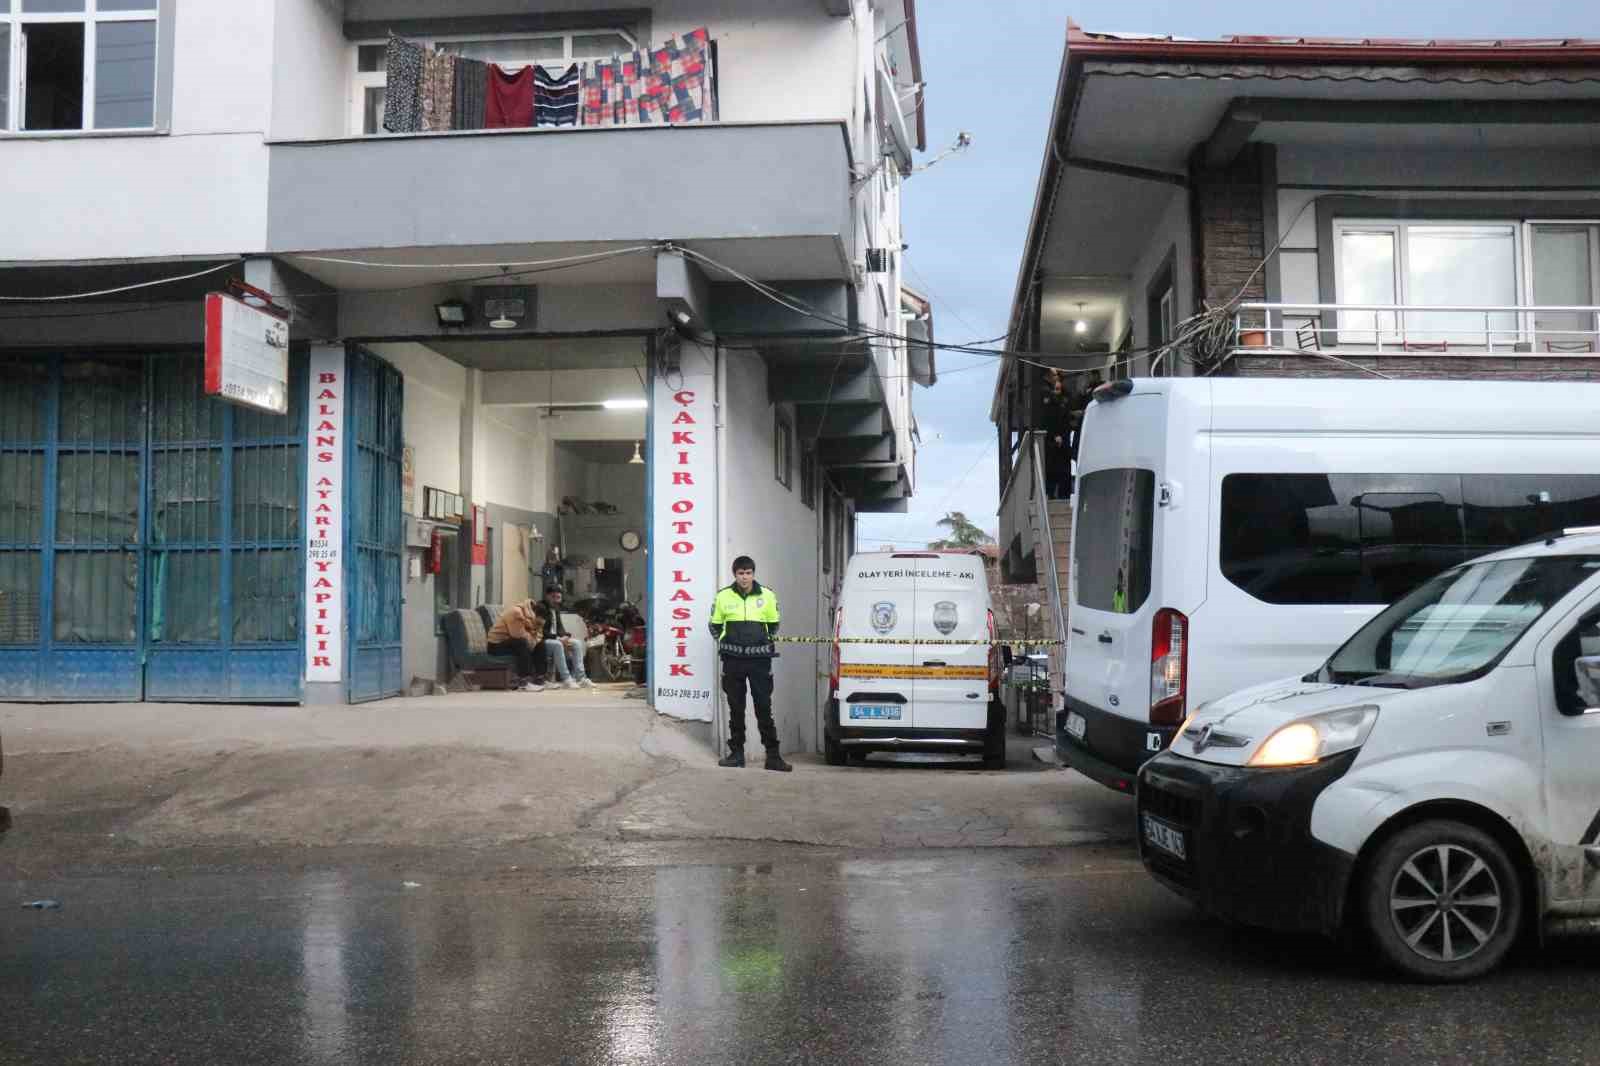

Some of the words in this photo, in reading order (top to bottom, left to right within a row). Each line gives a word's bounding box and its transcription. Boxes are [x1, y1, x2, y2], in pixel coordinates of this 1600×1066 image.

[316, 373, 337, 463] BALANS
[672, 390, 696, 486] ÇAKIR
[315, 477, 333, 539] AYARI
[671, 499, 694, 555] OTO
[858, 570, 881, 578] OLAY
[882, 569, 903, 578] YERİ
[904, 569, 953, 578] İNCELEME
[312, 561, 333, 666] YAPILIR
[669, 570, 694, 676] LASTİK
[663, 688, 678, 697] 0534
[679, 688, 691, 698] 298
[702, 690, 710, 699] 49
